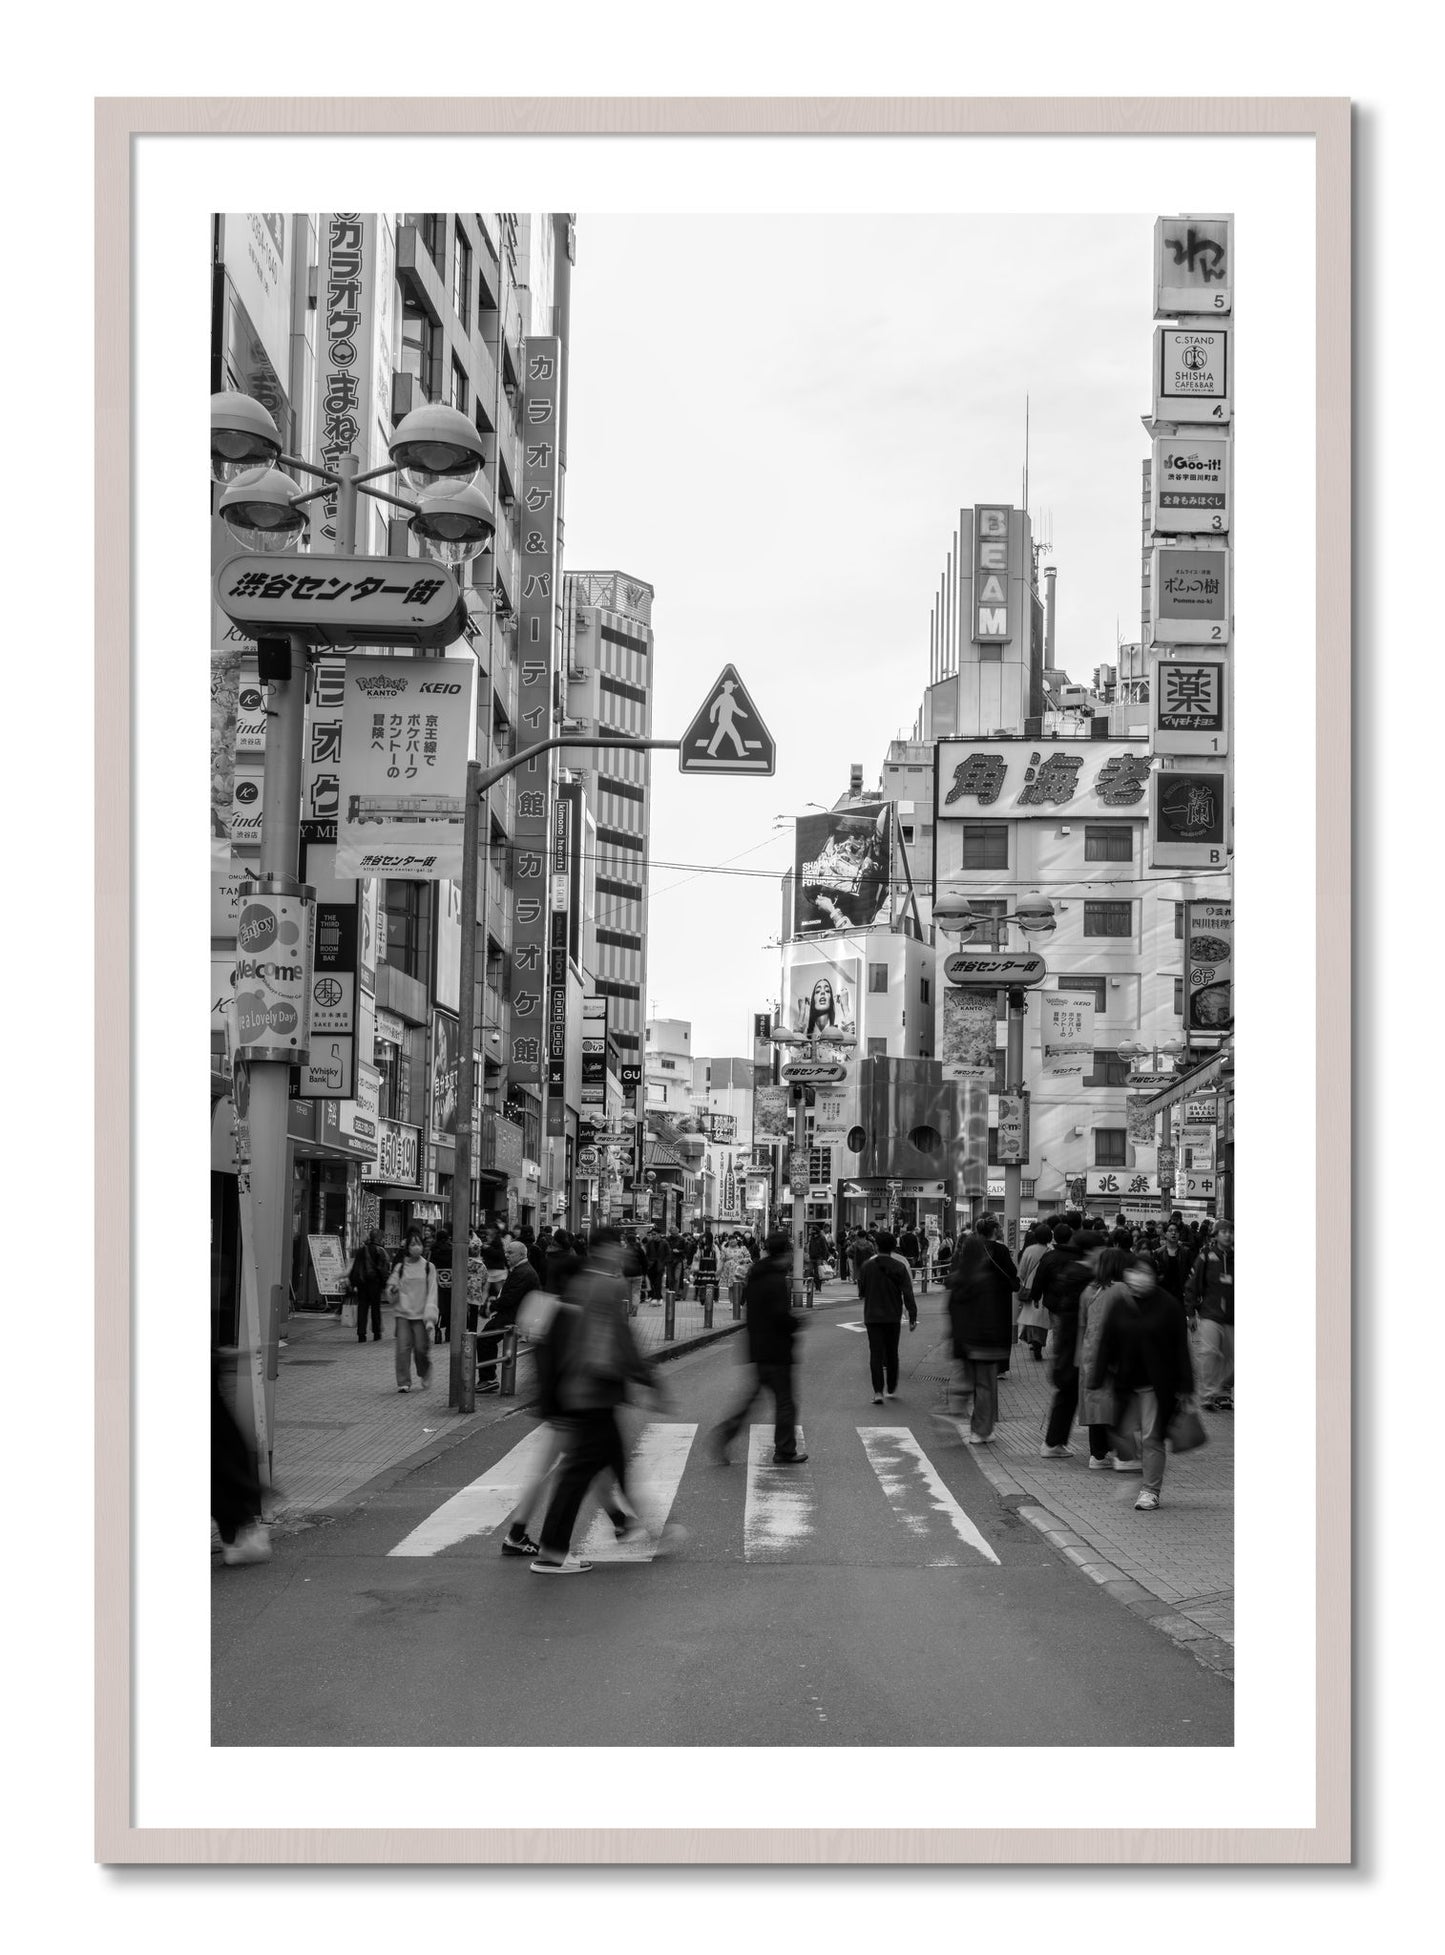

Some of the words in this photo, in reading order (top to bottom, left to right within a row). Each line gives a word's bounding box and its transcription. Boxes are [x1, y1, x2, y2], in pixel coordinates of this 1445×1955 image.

[327, 219, 363, 342] カラオケ
[1214, 295, 1224, 308] 5
[1175, 336, 1215, 344] C.STAND
[1175, 371, 1214, 381] SHISHA
[1175, 381, 1214, 389] CAFE&BAR
[1213, 404, 1223, 418] 4
[1174, 456, 1222, 471] Goo-it!
[1164, 495, 1222, 506] 全身もみほぐし
[1212, 515, 1222, 530] 3
[978, 509, 1007, 635] BEAM
[228, 572, 446, 605] 渋谷センター街
[1211, 626, 1222, 640] 2
[366, 689, 398, 697] KANTO
[420, 682, 461, 695] KEIO
[1167, 668, 1211, 712] 薬
[386, 712, 403, 779] カントーの
[423, 714, 438, 767] 京王線で
[1211, 737, 1218, 752] 1
[945, 753, 1151, 805] 角海老
[556, 803, 566, 836] kimono
[1210, 849, 1220, 863] B
[951, 961, 1040, 972] 渋谷センター街
[1190, 968, 1215, 986] 6F
[280, 1010, 296, 1023] Day!
[309, 1075, 327, 1083] Bank
[310, 1067, 339, 1077] Whisky
[623, 1070, 641, 1079] GU
[726, 1172, 734, 1209] BEER
